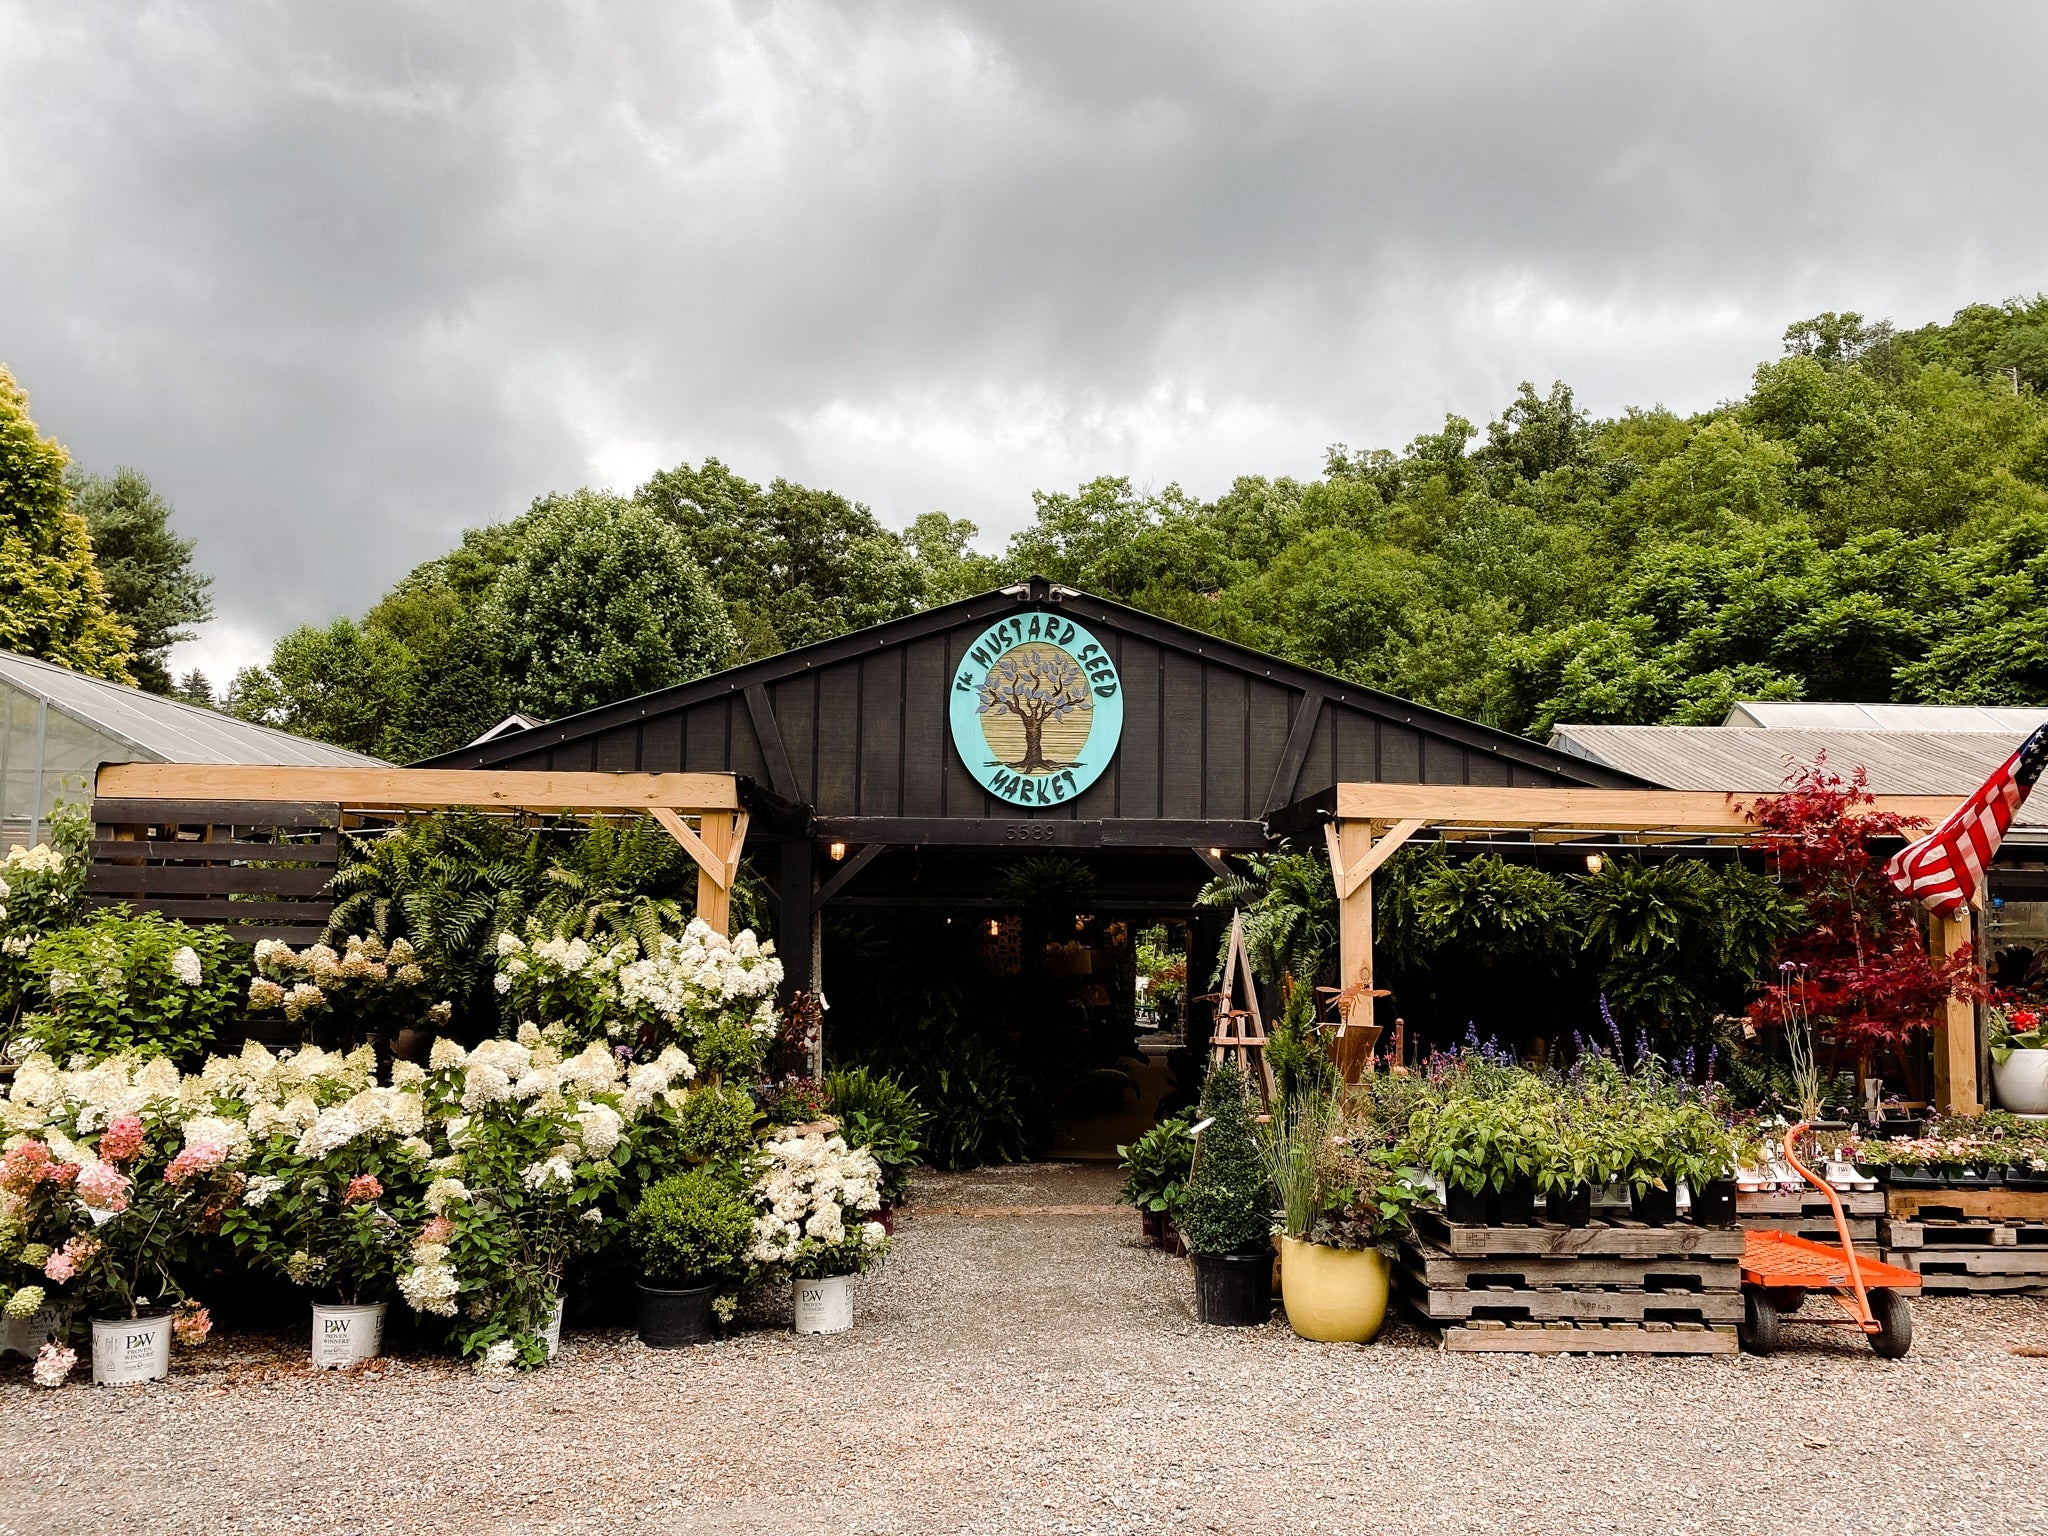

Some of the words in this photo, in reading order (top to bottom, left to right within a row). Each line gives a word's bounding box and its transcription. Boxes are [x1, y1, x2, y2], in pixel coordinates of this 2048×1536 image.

[970, 615, 1075, 670] MUSTARD
[1077, 643, 1117, 698] SEED
[987, 768, 1079, 805] MARKET
[1006, 824, 1056, 841] 5589
[802, 1290, 824, 1301] PW
[324, 1319, 351, 1333] PW
[126, 1332, 155, 1349] PW
